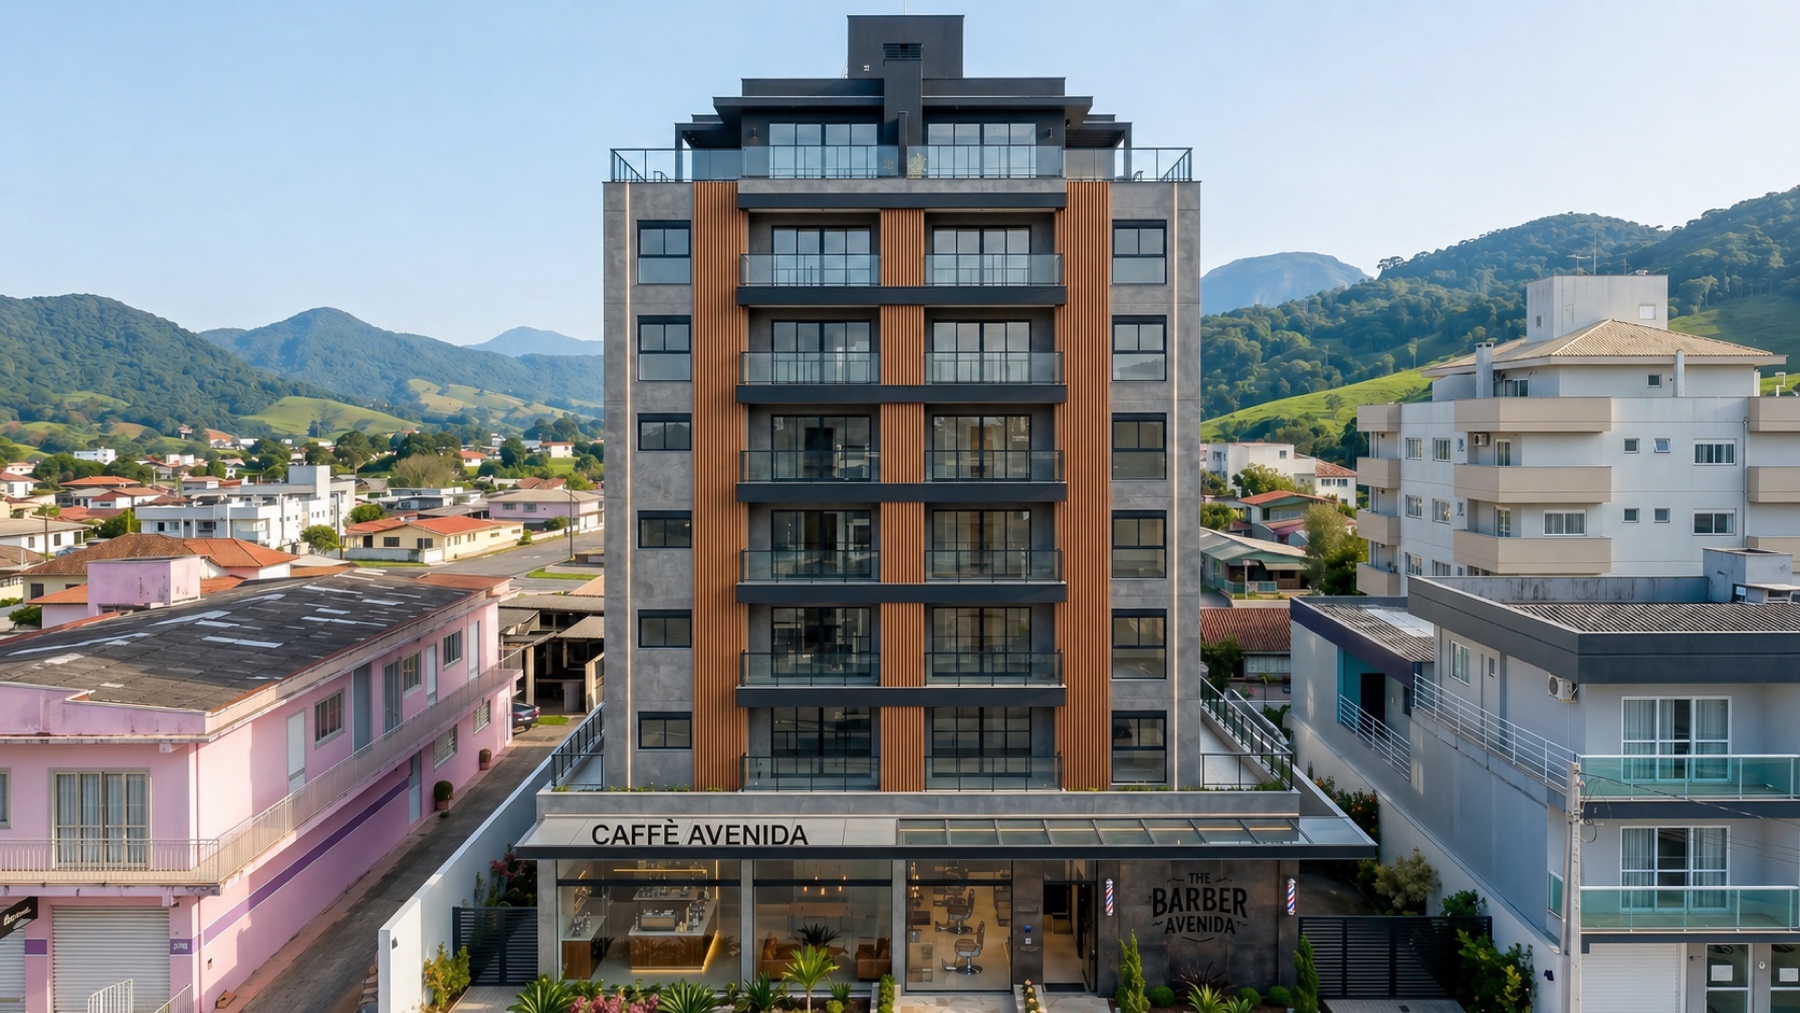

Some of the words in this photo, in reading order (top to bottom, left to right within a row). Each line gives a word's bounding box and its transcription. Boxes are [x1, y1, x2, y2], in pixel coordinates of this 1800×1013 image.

[591, 818, 679, 846] CAFFÈ
[687, 824, 809, 846] AVENIDA
[1188, 872, 1211, 884] THE
[1152, 887, 1248, 918] BARBER
[1164, 915, 1236, 935] AVENIDA
